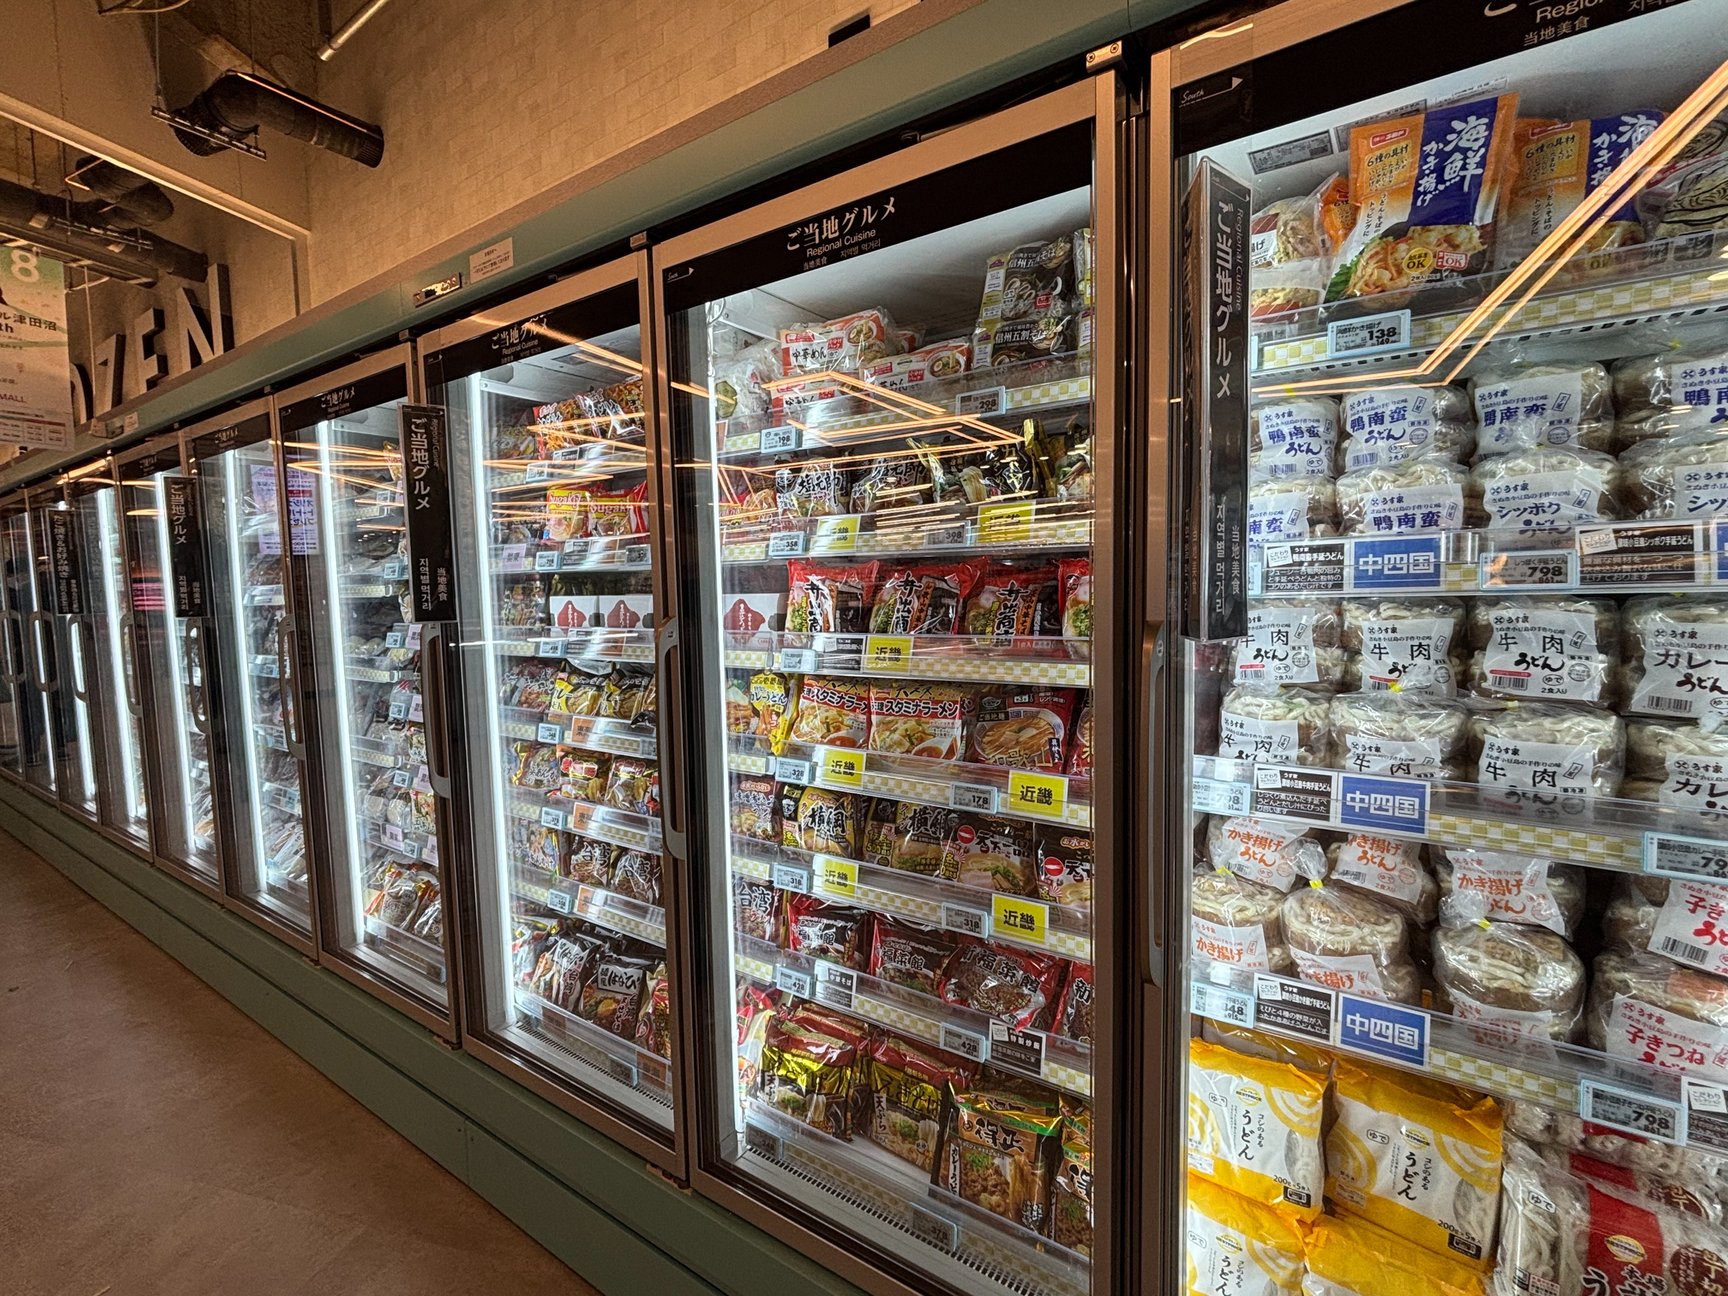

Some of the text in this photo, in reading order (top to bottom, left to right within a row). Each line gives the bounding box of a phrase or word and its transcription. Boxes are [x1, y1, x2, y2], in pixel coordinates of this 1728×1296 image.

[1523, 15, 1591, 46] 当地美食
[1181, 89, 1204, 104] South
[1366, 144, 1409, 168] 6種の具材
[1442, 115, 1491, 193] 海鮮
[1416, 140, 1443, 207] かき揚げ
[787, 197, 896, 251] ご当地グルメ
[806, 229, 876, 258] Regional Cuisine
[1236, 208, 1244, 264] Regional
[10, 249, 39, 282] 8
[1406, 259, 1428, 270] OK
[1445, 257, 1464, 267] OK
[1216, 200, 1233, 399] ご当地グルメ
[1367, 326, 1397, 341] 138
[1376, 338, 1391, 347] 149
[979, 400, 997, 409] 298
[1350, 406, 1409, 433] 鴨南蛮
[777, 435, 791, 444] 198
[1268, 425, 1322, 445] 鴨南蛮
[1364, 427, 1406, 446] うどん
[1285, 441, 1323, 457] うどん
[410, 418, 430, 510] ご当地グルメ
[1503, 480, 1529, 492] うす家
[1381, 494, 1405, 505] うす家
[170, 484, 187, 545] ご当地グルメ
[1497, 501, 1562, 520] シッポク
[1373, 511, 1442, 531] 鴨南蛮
[945, 532, 962, 540] 398
[1215, 504, 1225, 615] 지역별 먹거리
[1231, 525, 1240, 594] 当地美食
[1359, 552, 1435, 576] 中四国
[1528, 566, 1563, 577] 798
[1505, 615, 1529, 624] うす家
[1377, 625, 1398, 635] うす家
[1669, 630, 1698, 639] うす家
[1498, 632, 1564, 655] 牛肉
[875, 646, 902, 662] 近畿
[1253, 648, 1289, 662] うどん
[1514, 652, 1565, 672] うどん
[1544, 676, 1562, 684] ゆで
[1496, 746, 1521, 756] うす家
[830, 759, 856, 776] 近畿
[1485, 762, 1557, 788] 牛肉
[1691, 762, 1723, 774] うす家
[971, 794, 989, 804] 178
[1020, 784, 1053, 806] 近畿
[1346, 790, 1420, 819] 中四国
[1227, 829, 1284, 852] かき揚げ
[1240, 849, 1277, 867] うどん
[1357, 850, 1396, 871] うどん
[825, 868, 849, 888] 近畿
[1458, 873, 1524, 897] かき揚げ
[740, 881, 772, 916] 台湾
[963, 918, 980, 929] 318
[1003, 909, 1036, 931] 近畿
[1196, 938, 1244, 963] かき揚げ
[792, 981, 805, 991] 428
[1637, 1008, 1666, 1024] うす家
[1346, 1012, 1419, 1049] 中四国
[961, 1041, 978, 1052] 428
[1625, 1024, 1706, 1066] 子きつね
[875, 1094, 887, 1132] 天ぷら
[1632, 1110, 1670, 1130] 798
[1238, 1109, 1255, 1161] うどん
[1257, 1113, 1265, 1148] コシのある
[1368, 1131, 1388, 1144] ゆで
[1397, 1151, 1418, 1201] うどん
[1421, 1157, 1432, 1191] コシのある
[1530, 1193, 1554, 1211] ゆで
[1189, 1234, 1206, 1248] ゆで
[1215, 1256, 1232, 1296] うどん
